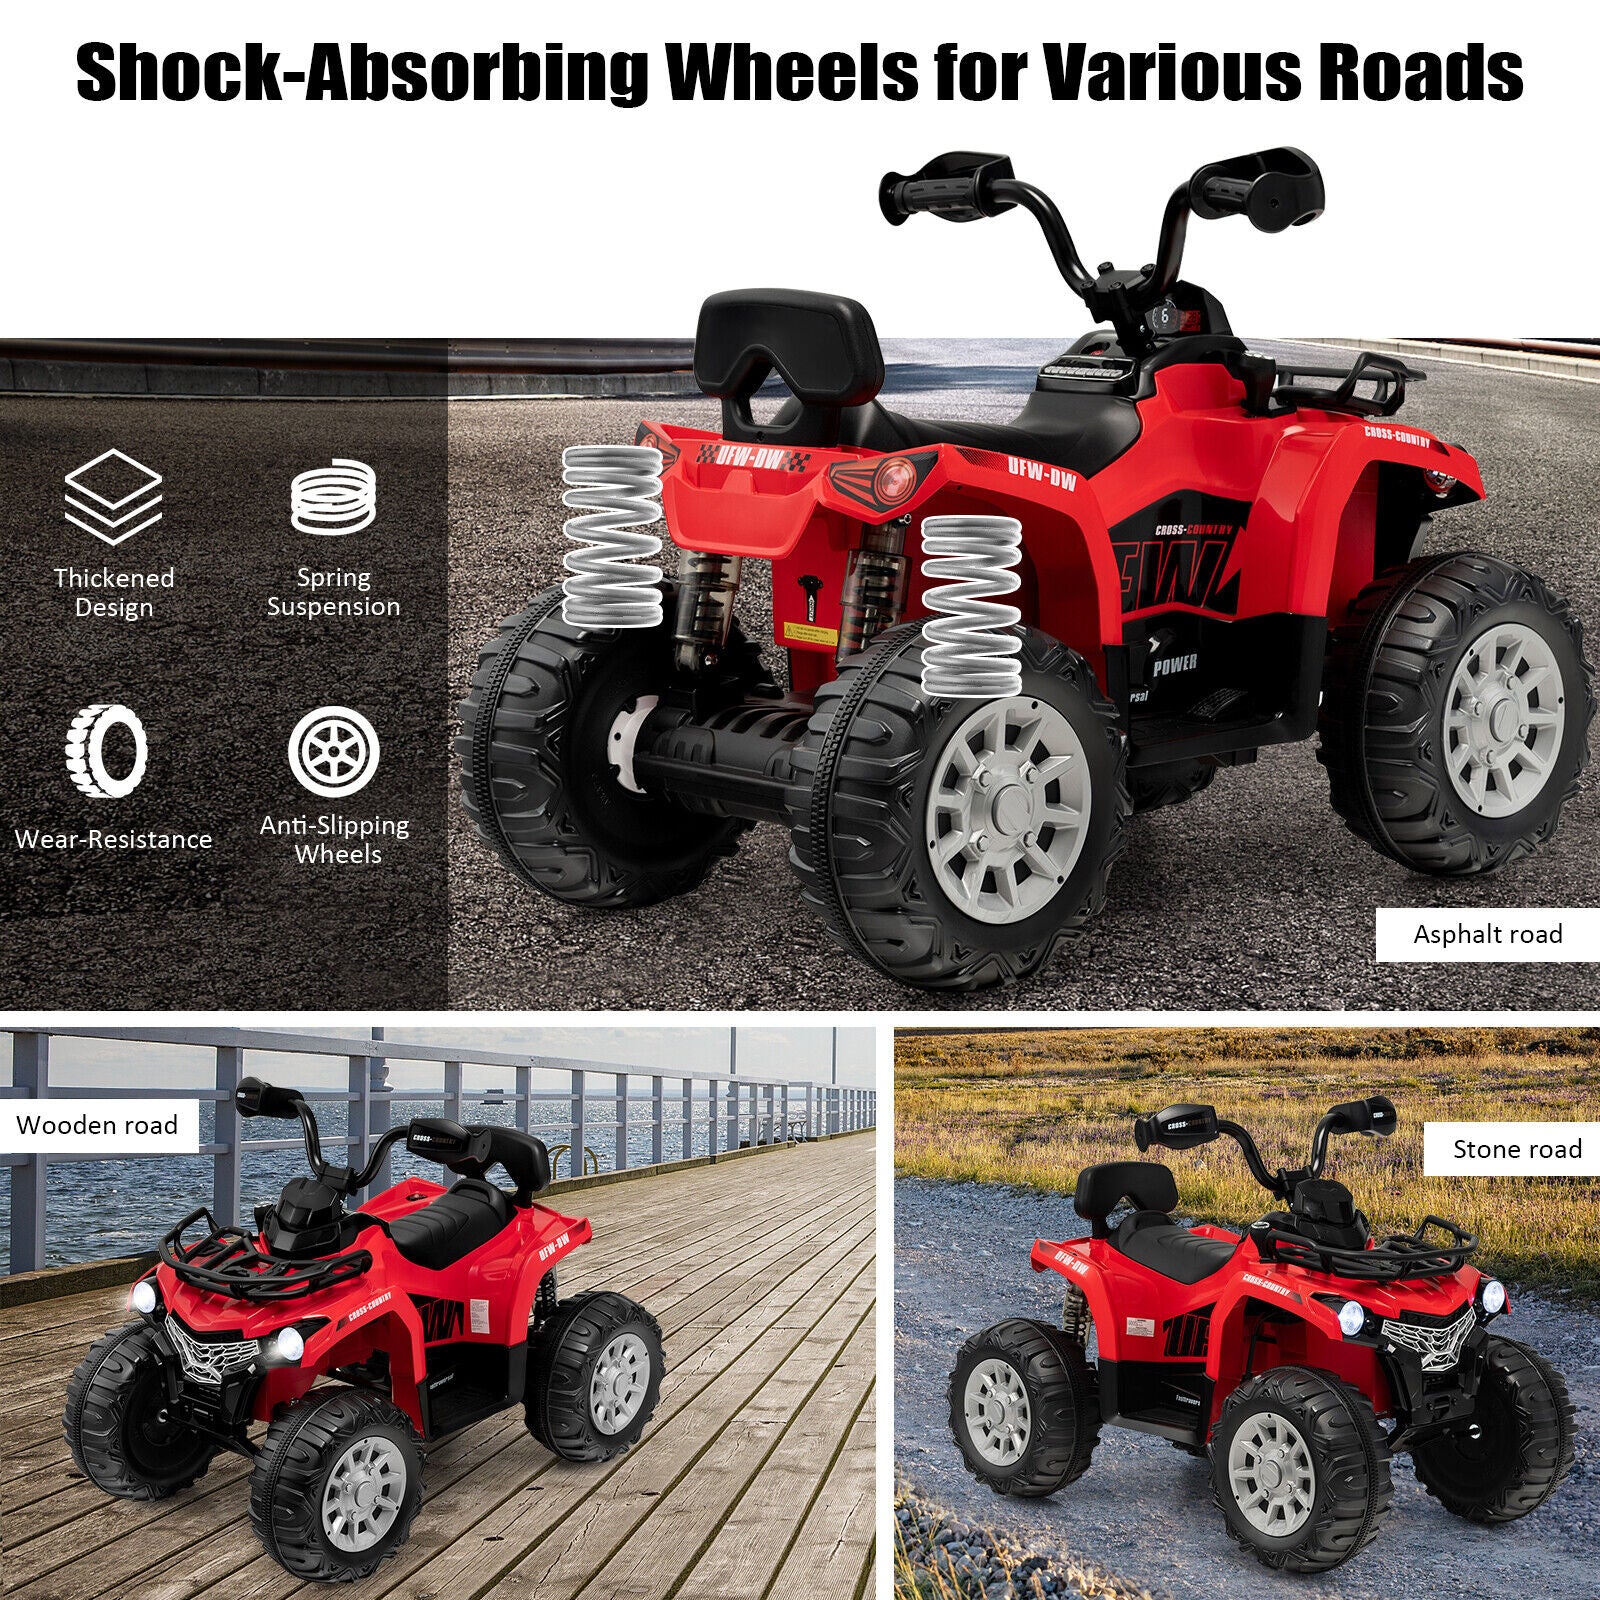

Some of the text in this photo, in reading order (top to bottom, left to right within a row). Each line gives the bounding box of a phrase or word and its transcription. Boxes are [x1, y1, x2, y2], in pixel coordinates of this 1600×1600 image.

[1364, 425, 1431, 449] CROSS-COUNTRY
[1007, 455, 1077, 492] UFW-DW
[1155, 523, 1233, 536] CROSS-COUNTRY
[1153, 653, 1198, 678] POWER
[1242, 1273, 1291, 1297] CROSS-COUNTRY
[348, 1291, 392, 1322] CROSS-COUNTRY
